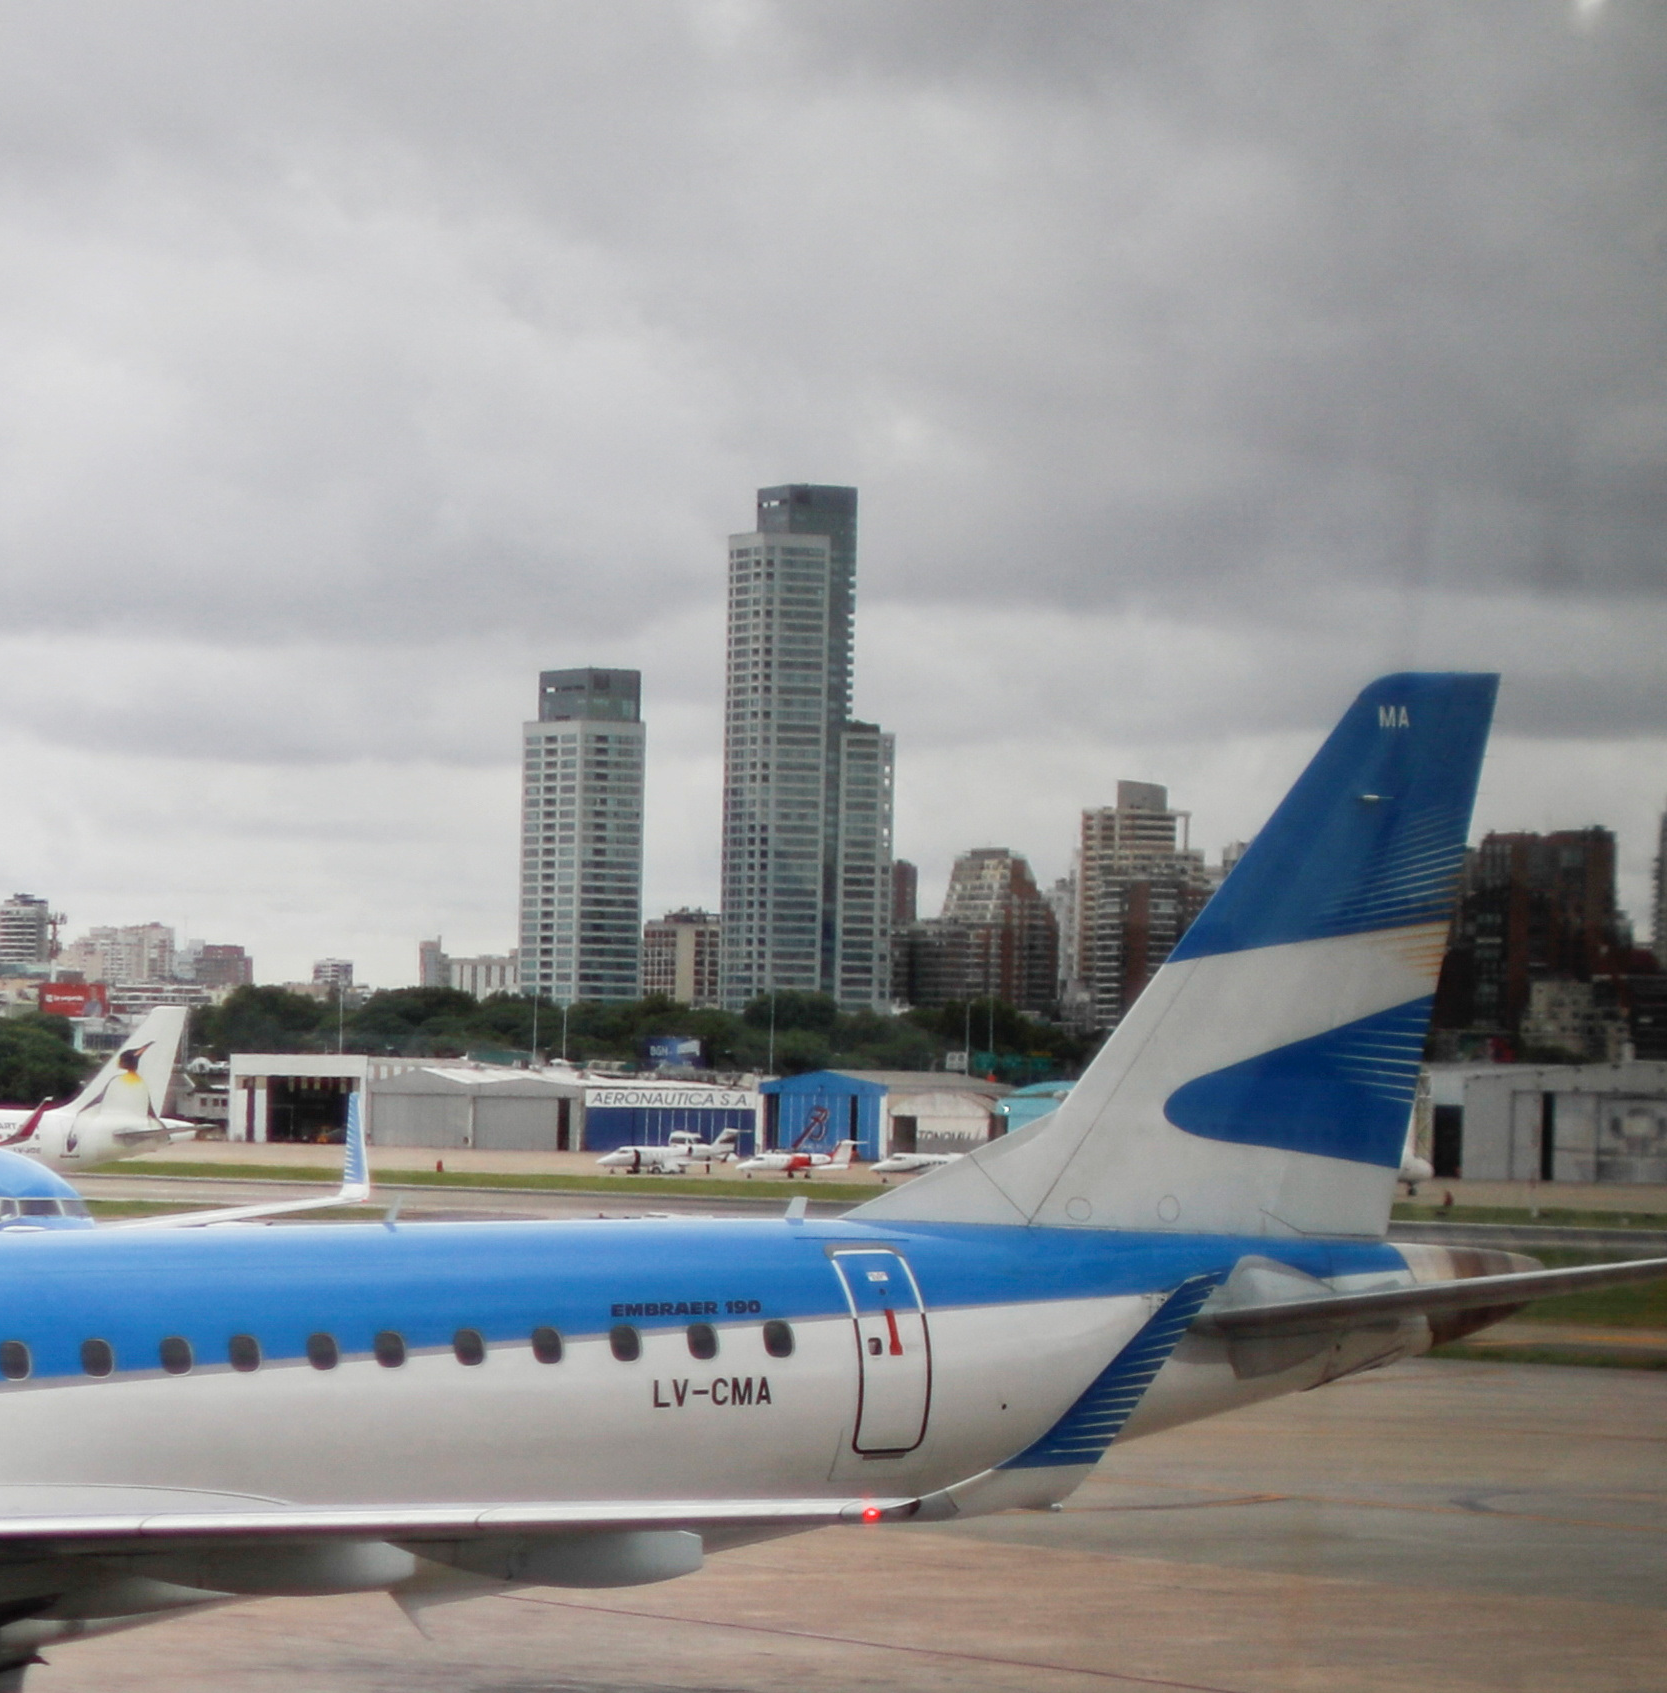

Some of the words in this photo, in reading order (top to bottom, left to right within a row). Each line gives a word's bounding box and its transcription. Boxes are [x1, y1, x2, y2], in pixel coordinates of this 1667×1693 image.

[1378, 706, 1410, 731] MA
[591, 1092, 715, 1106] AERONAUTICA
[611, 1301, 718, 1318] EMBRAER
[725, 1300, 762, 1315] 190
[653, 1376, 772, 1408] LV-CMA
